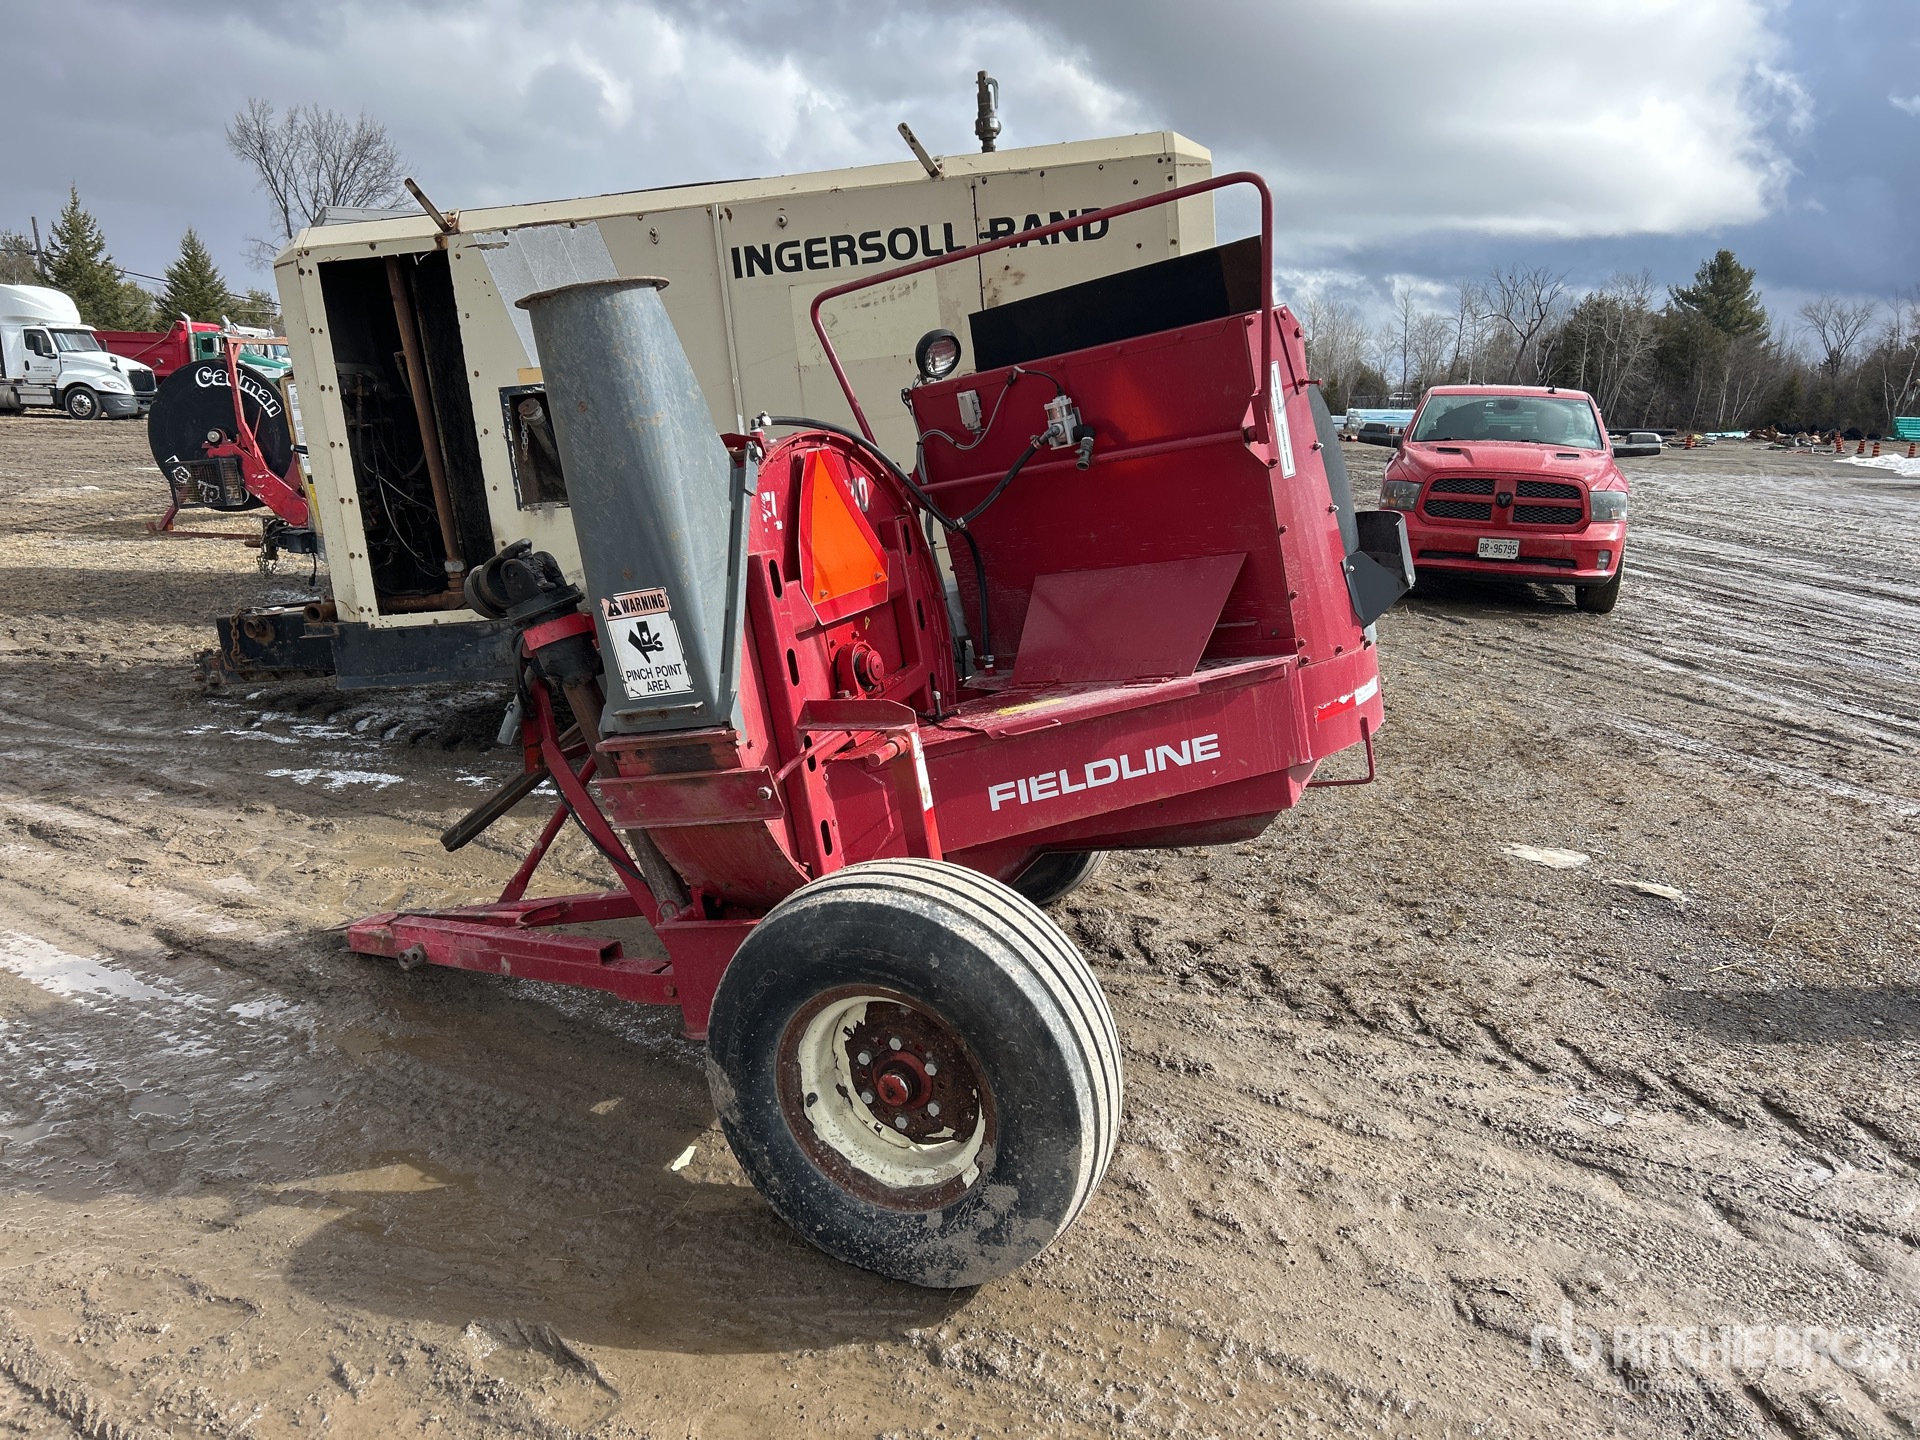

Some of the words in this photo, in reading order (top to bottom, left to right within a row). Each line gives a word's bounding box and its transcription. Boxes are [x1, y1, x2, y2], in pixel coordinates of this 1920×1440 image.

[731, 222, 967, 280] INGERSOLL
[619, 593, 666, 614] WARNING
[626, 667, 654, 682] PINCH
[655, 663, 682, 679] POINT
[647, 680, 672, 693] AREA
[987, 733, 1222, 812] FIELDLINE
